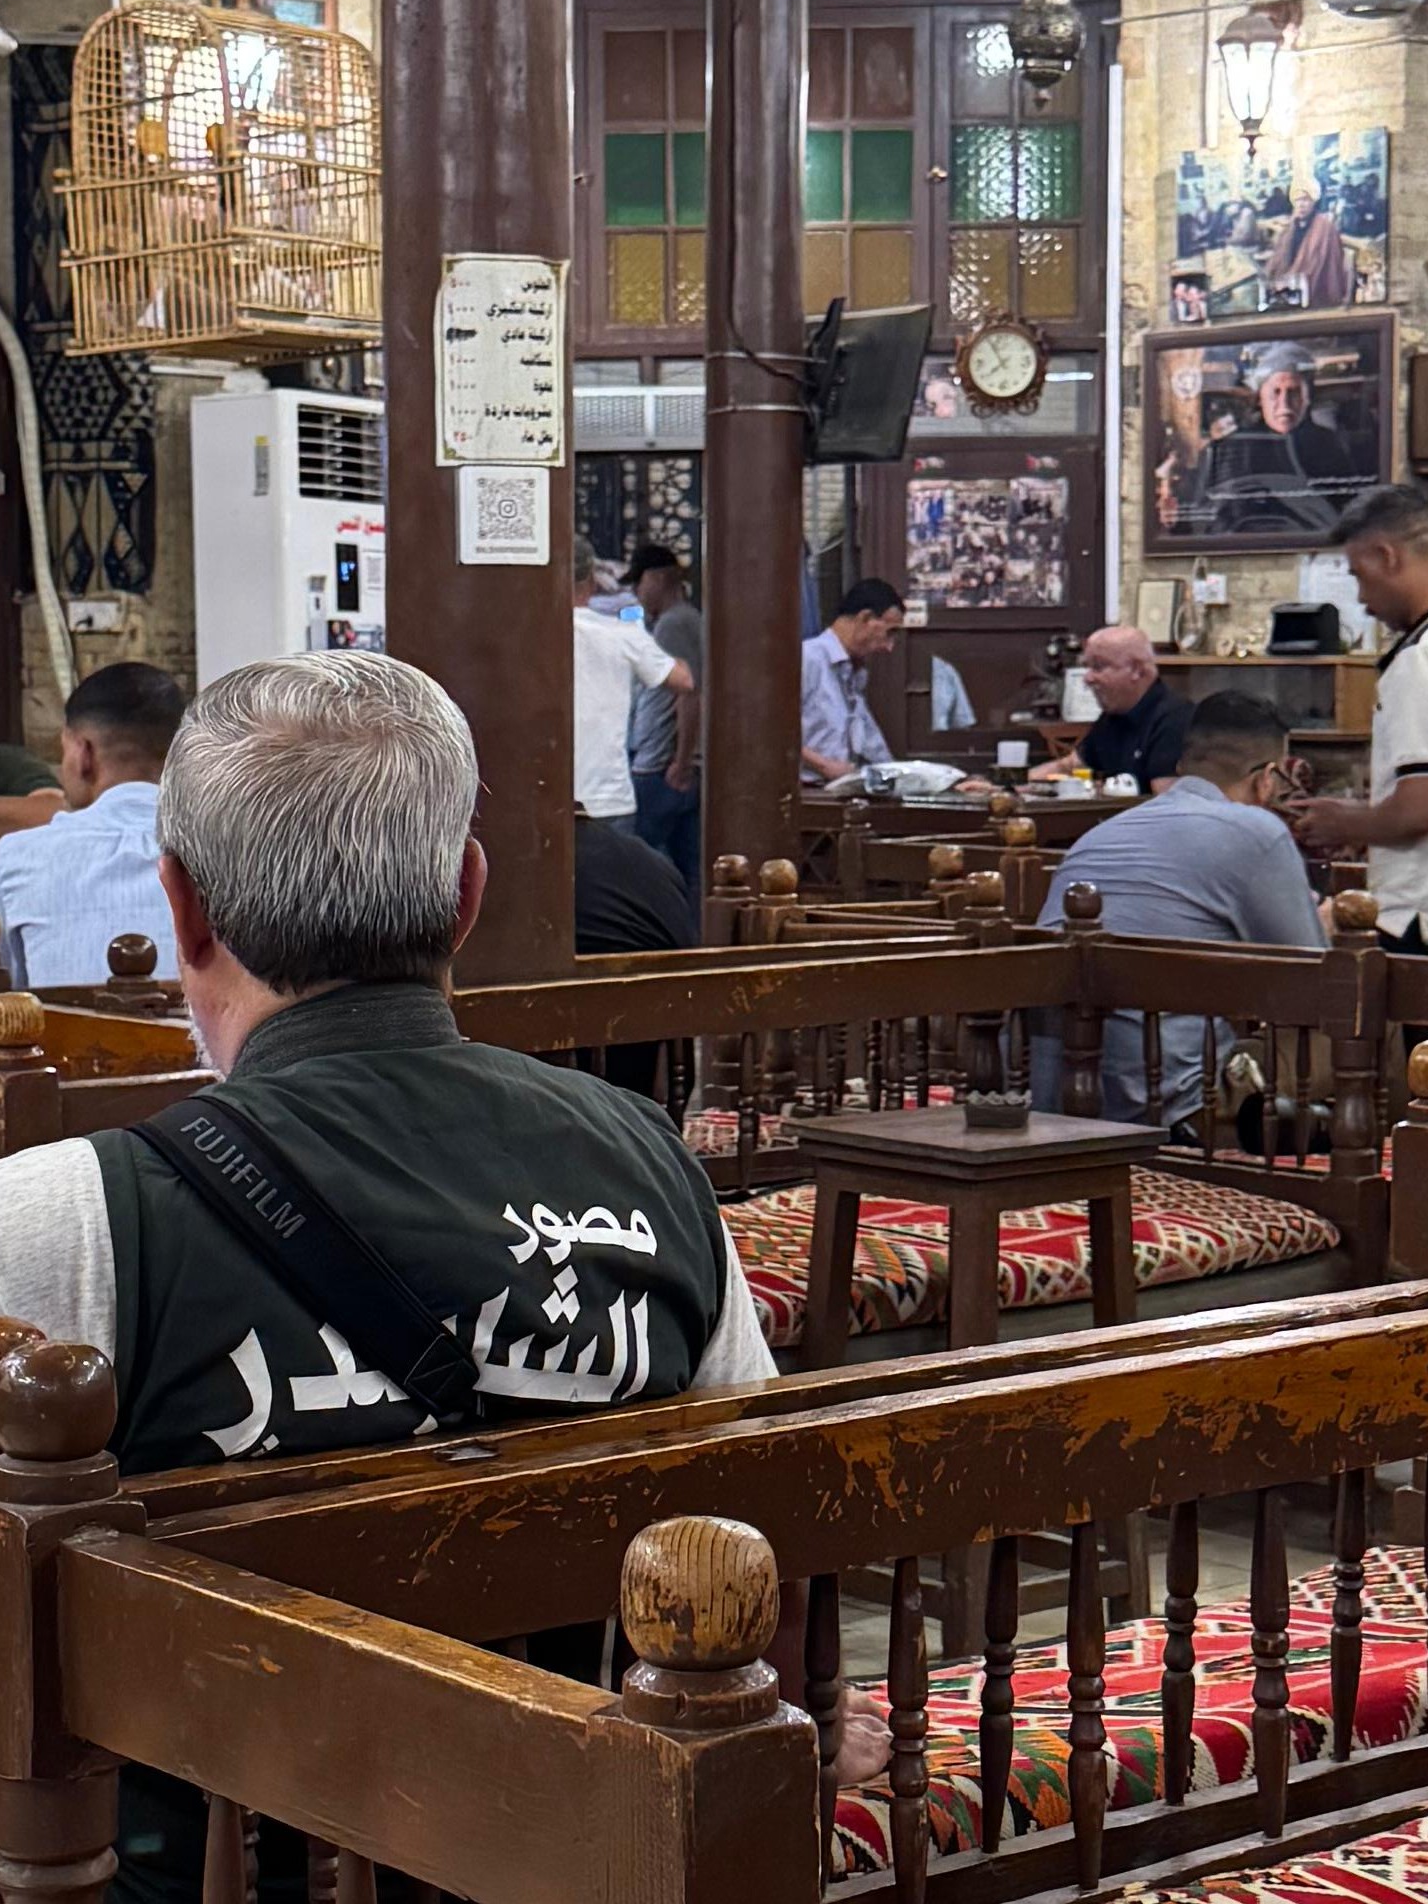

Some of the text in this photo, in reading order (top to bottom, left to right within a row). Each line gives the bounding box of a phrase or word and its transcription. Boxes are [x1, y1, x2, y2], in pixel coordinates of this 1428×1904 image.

[179, 1116, 308, 1240] FUJIFILM
[501, 1201, 659, 1266] مصور
[202, 1264, 651, 1458] الشادر
